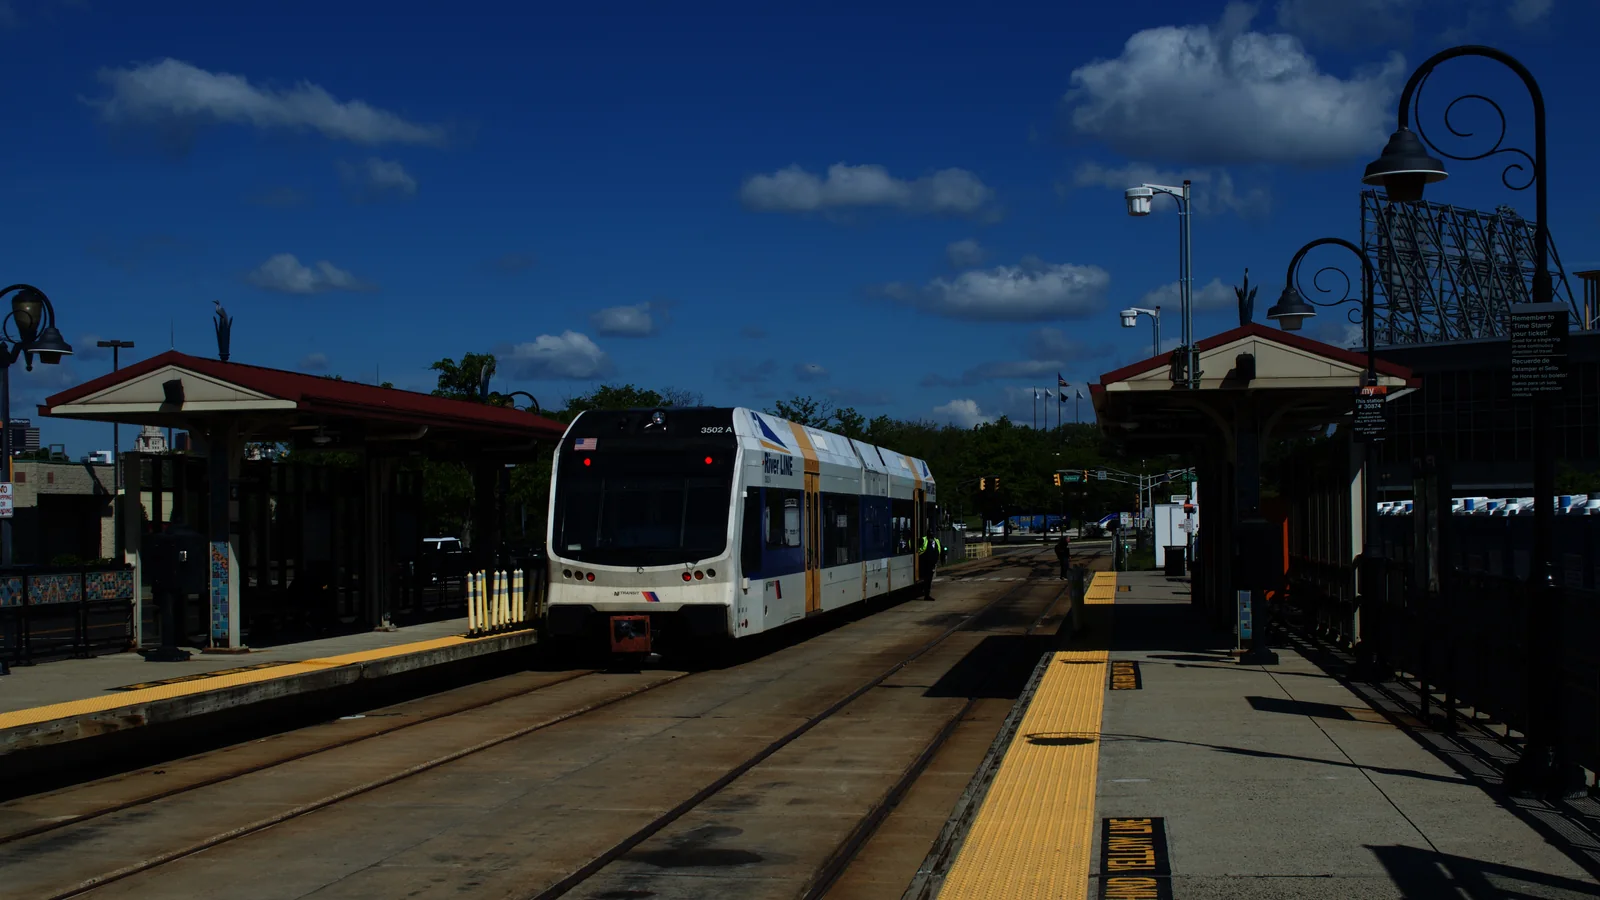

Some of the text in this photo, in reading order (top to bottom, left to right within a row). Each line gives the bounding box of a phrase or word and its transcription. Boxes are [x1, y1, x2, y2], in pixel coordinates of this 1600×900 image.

[1361, 388, 1375, 397] my
[700, 426, 724, 434] 3502
[764, 451, 793, 477] River LINE
[1107, 836, 1156, 872] YELLOW
